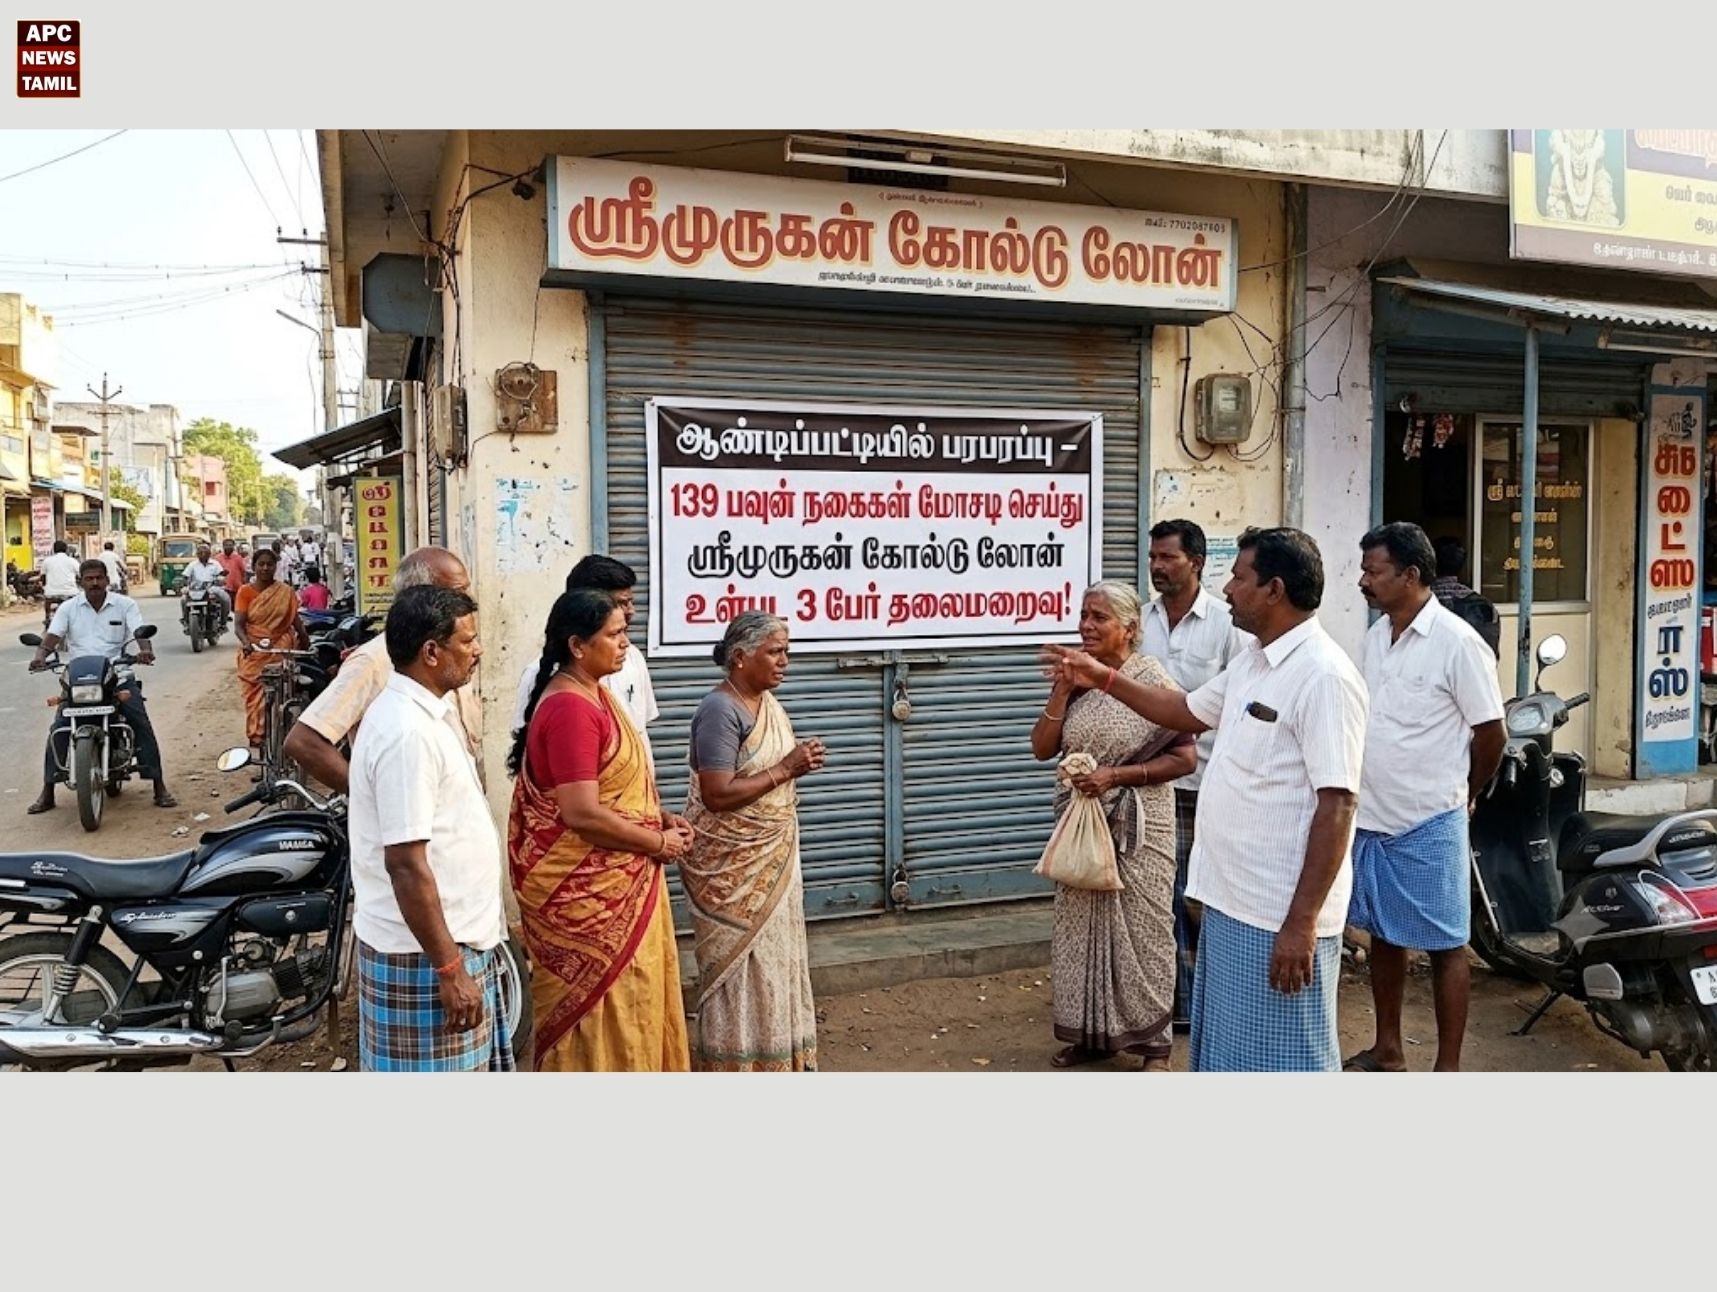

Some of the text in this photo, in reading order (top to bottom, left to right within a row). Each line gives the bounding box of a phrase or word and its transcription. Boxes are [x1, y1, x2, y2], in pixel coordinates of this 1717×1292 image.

[568, 175, 1222, 287] ஸ்ரீமுருகன் கோல்டு லோன்
[676, 417, 935, 464] ஆண்டிப்பட்டியில்
[942, 424, 1053, 467] பரபரப்பு
[671, 478, 1084, 529] 139 பவுன் நகைகள் மோசடி செய்து
[687, 530, 1065, 579] ஸ்ரீமுருகன் கோல்டு லோன்
[797, 589, 817, 622] 3
[825, 582, 881, 622] பேர்
[887, 582, 1072, 626] தலைமறைவு!
